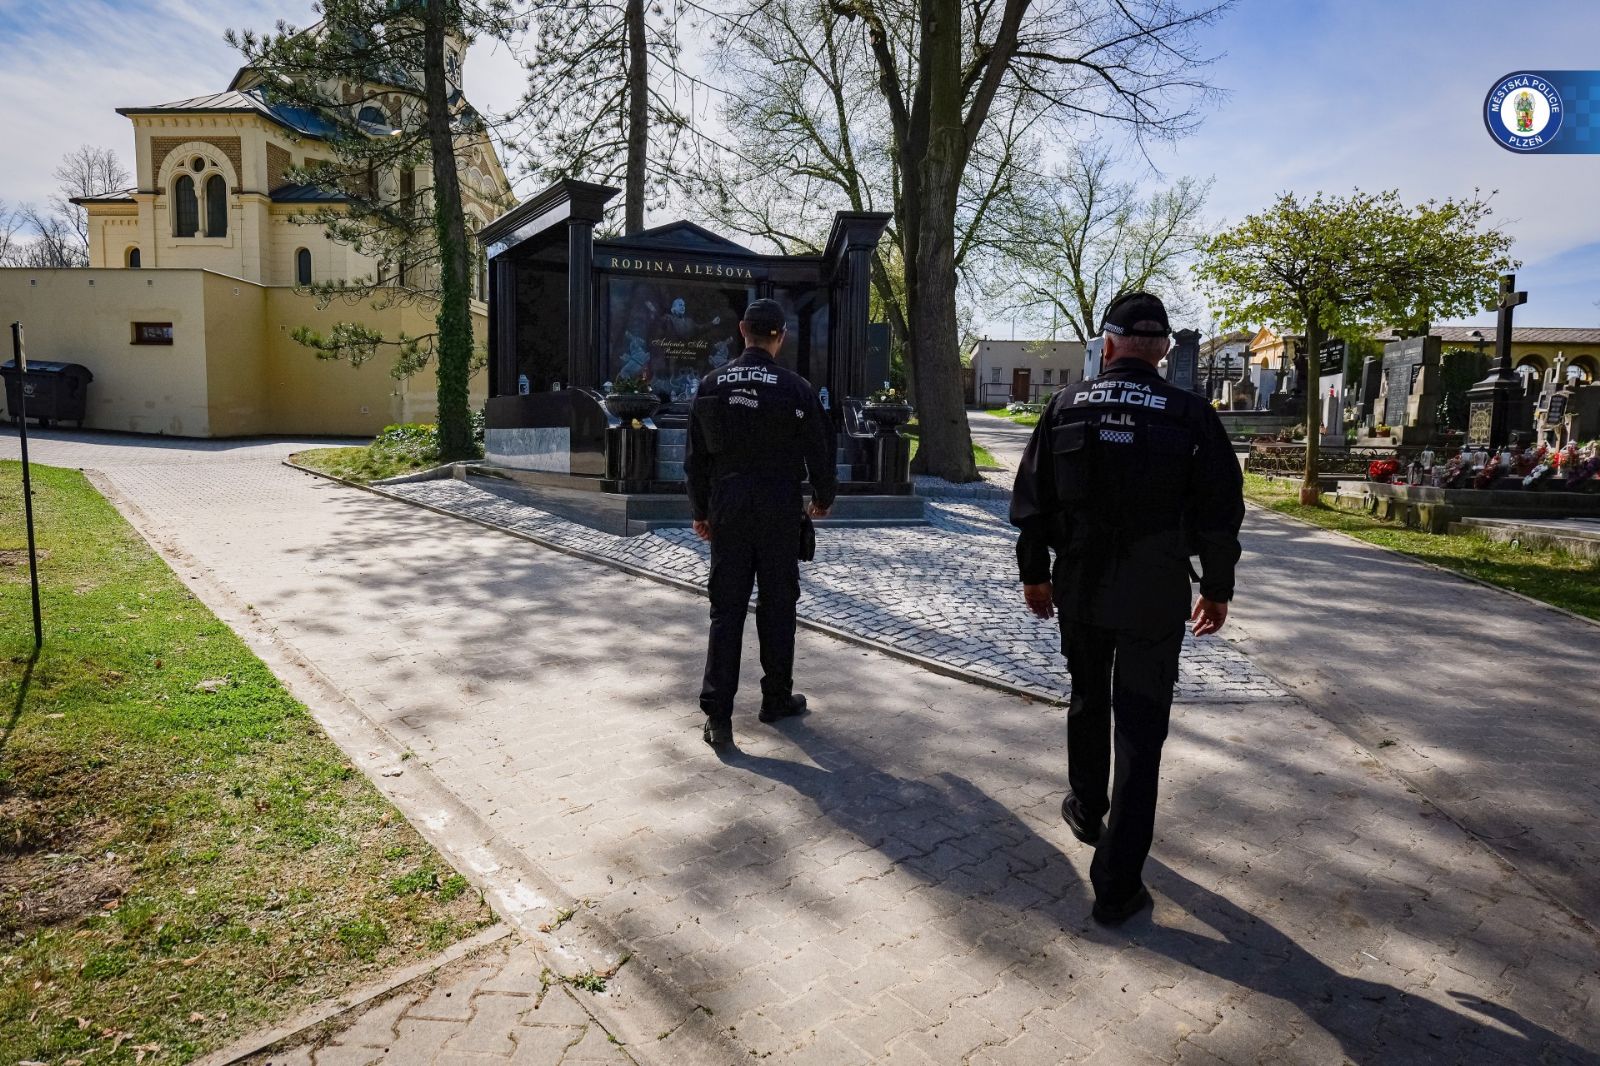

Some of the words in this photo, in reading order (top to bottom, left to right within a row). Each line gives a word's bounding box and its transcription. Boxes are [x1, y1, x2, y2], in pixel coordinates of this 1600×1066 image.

[611, 257, 674, 273] RODINA
[684, 264, 752, 279] ALEŠOVA
[717, 371, 779, 385] POLICIE
[1073, 390, 1168, 410] POLICIE
